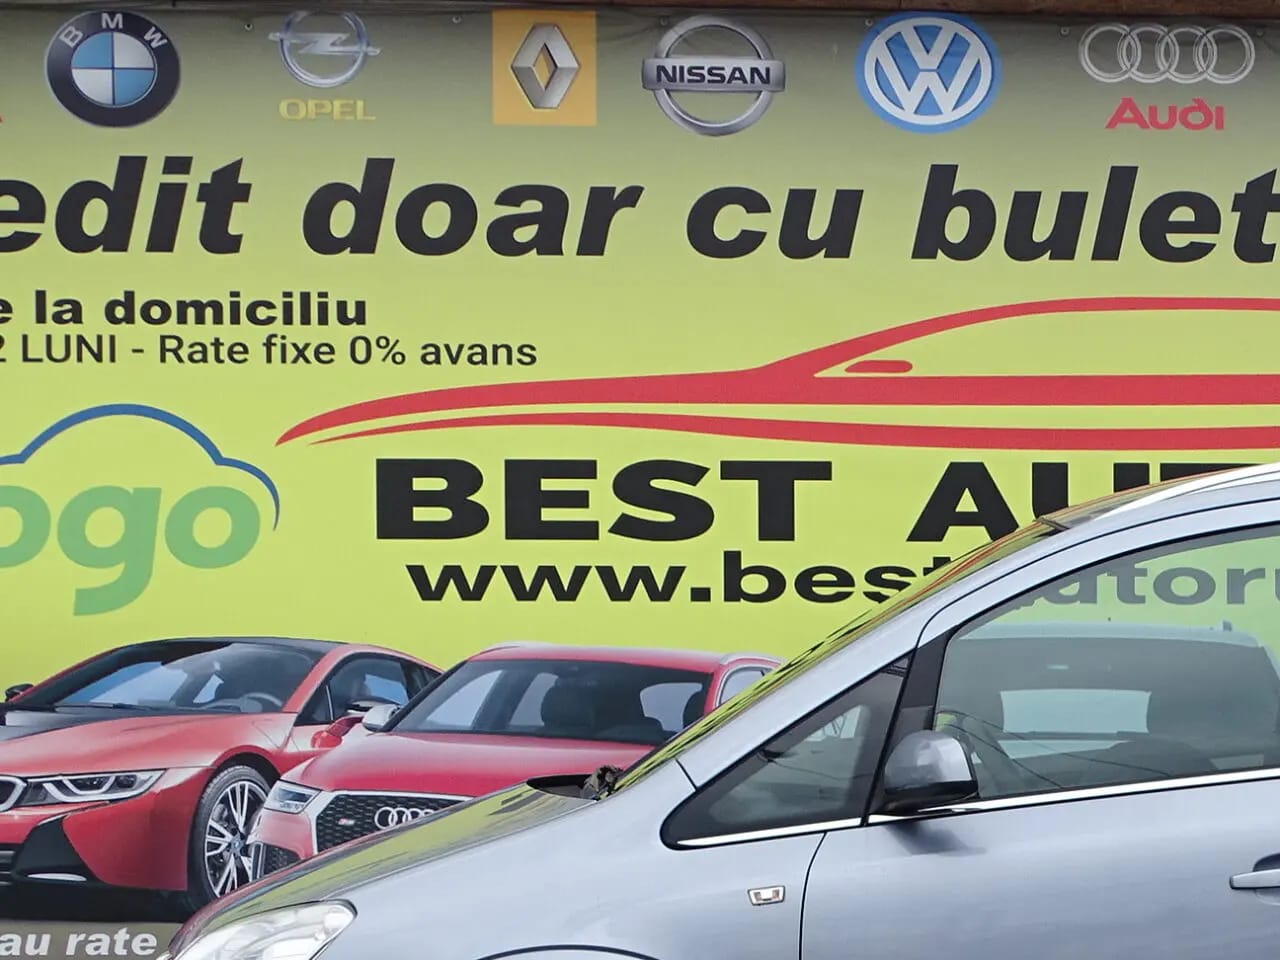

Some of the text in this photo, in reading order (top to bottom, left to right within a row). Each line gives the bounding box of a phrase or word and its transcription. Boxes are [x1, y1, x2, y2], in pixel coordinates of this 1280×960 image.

[59, 13, 168, 48] BMW
[656, 64, 772, 85] NISSAN
[280, 99, 376, 120] OPEL
[1106, 97, 1225, 131] Audi
[0, 156, 252, 254] edit
[303, 157, 645, 257] doar
[686, 186, 864, 259] cu
[35, 289, 83, 325] la
[105, 290, 367, 326] domiciliu
[22, 334, 116, 364] LUNI
[159, 334, 249, 364] Rate
[262, 333, 336, 365] fixe
[350, 335, 407, 366] 0%
[420, 342, 538, 366] avans
[376, 458, 1265, 542] BEST AU
[0, 927, 157, 956] au rate
